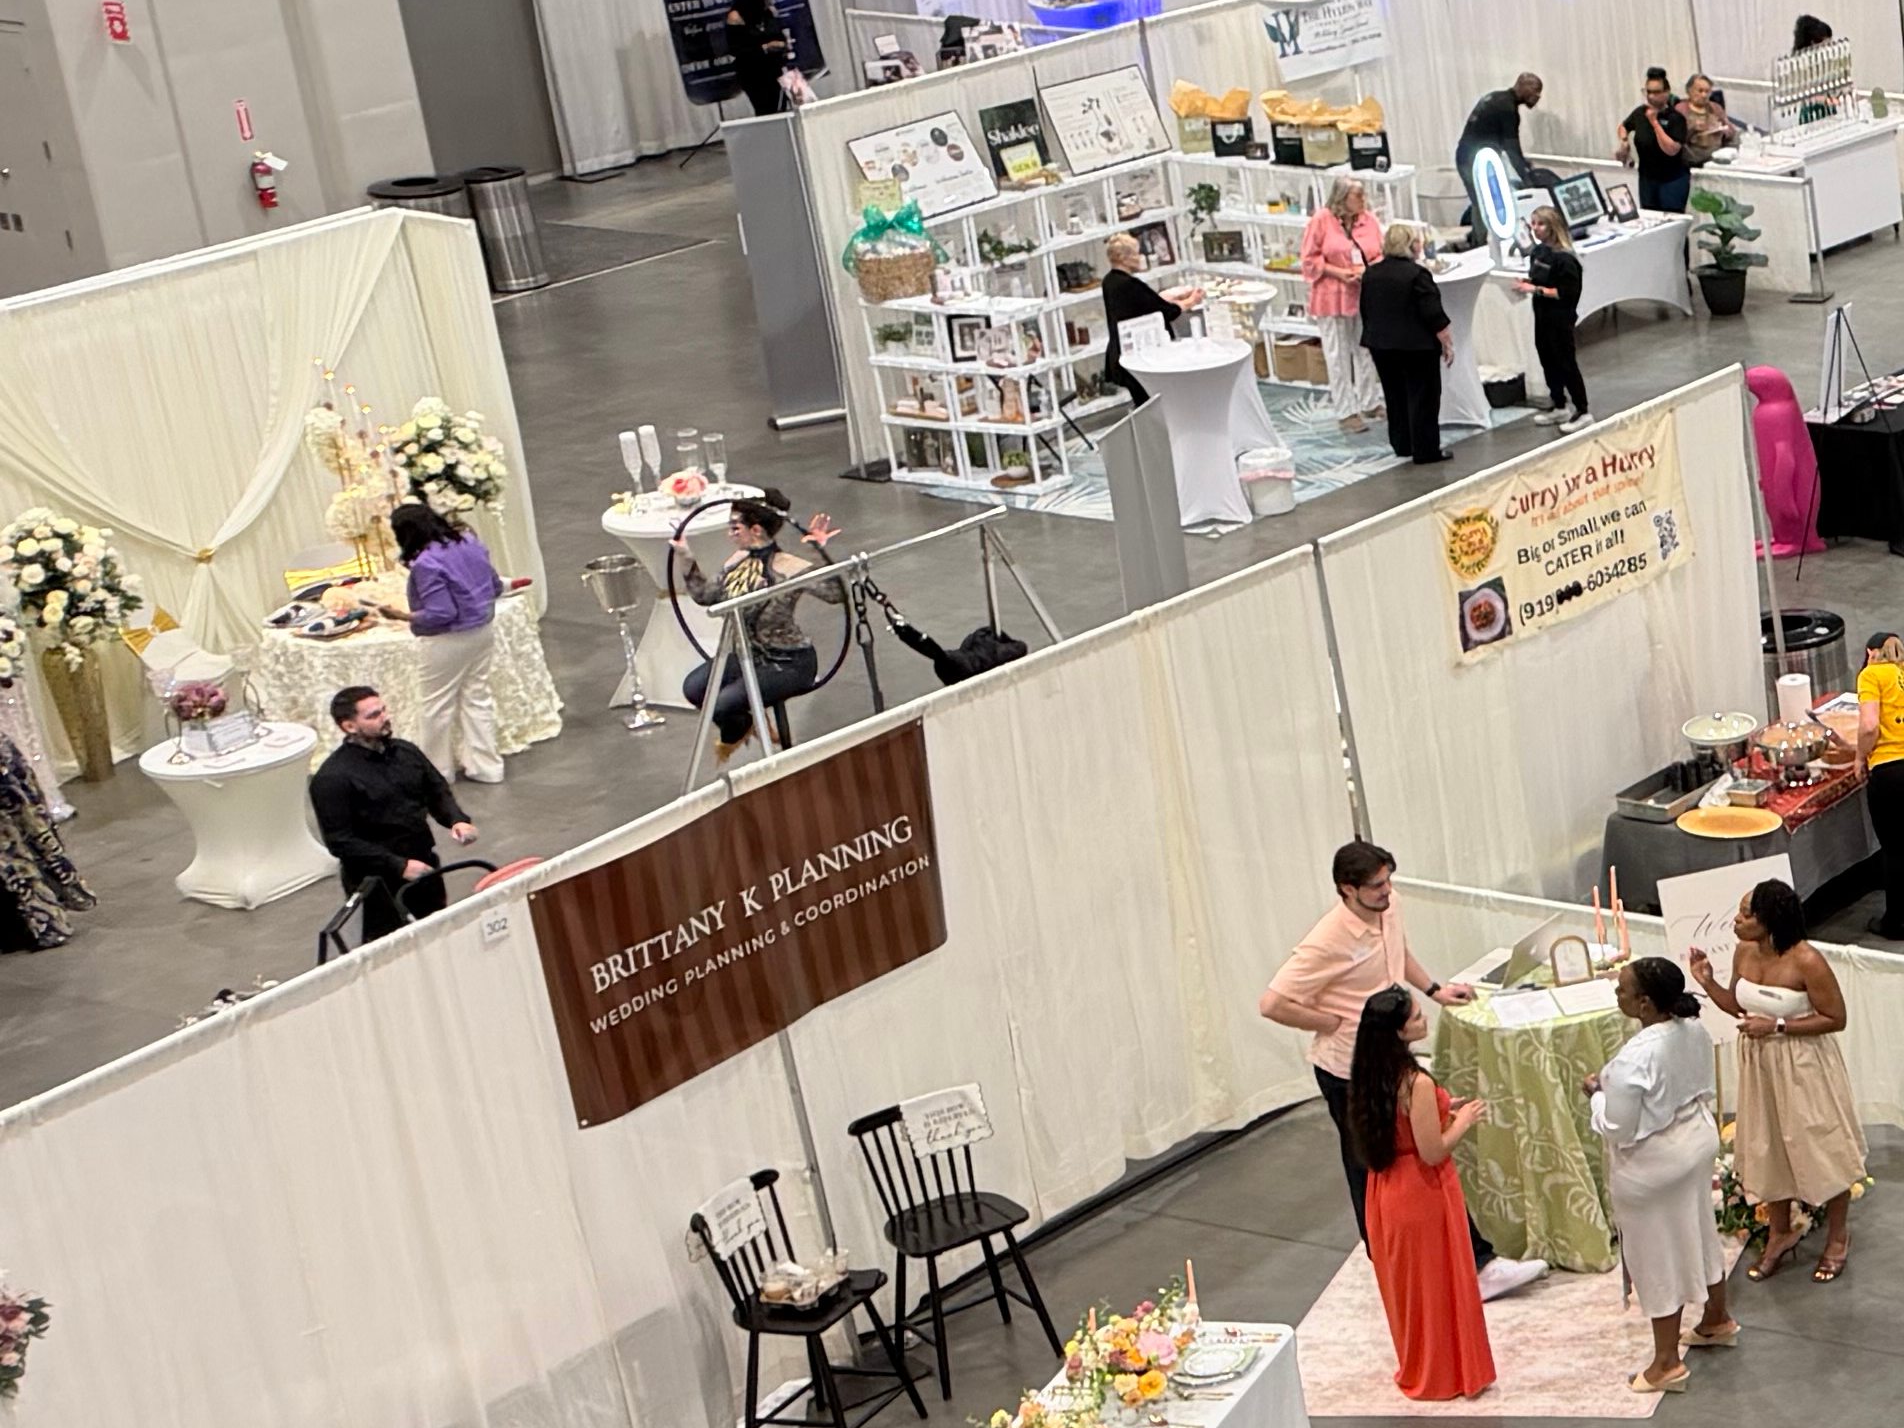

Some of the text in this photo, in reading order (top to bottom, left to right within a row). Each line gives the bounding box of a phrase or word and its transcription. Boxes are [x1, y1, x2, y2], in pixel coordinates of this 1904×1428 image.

[1601, 443, 1656, 477] Hurry
[1625, 499, 1648, 520] can
[1545, 543, 1593, 578] CATER
[589, 815, 913, 993] BRITTANY K PLANNING
[590, 855, 931, 1035] WEDDING PLANNING & COORDINATION
